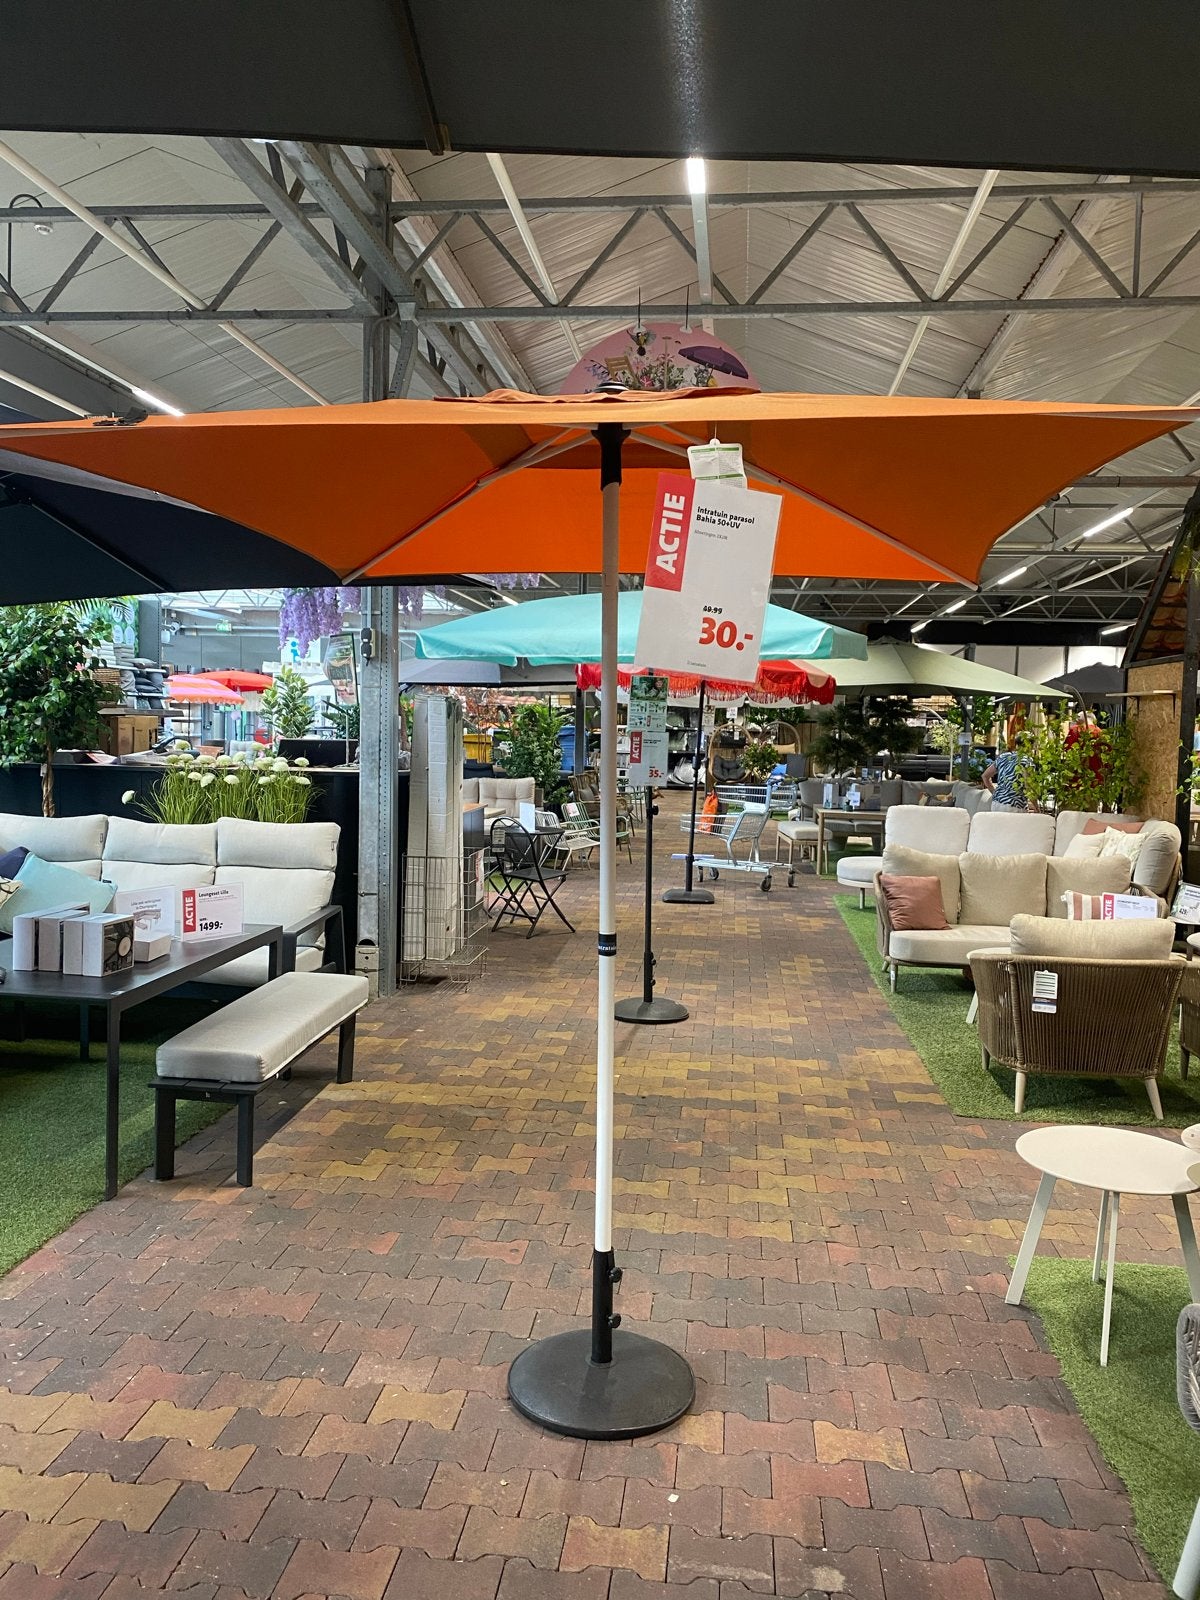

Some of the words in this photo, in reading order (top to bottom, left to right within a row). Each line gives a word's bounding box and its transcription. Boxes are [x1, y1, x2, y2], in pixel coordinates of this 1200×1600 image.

[696, 514, 716, 524] Bahia
[717, 518, 741, 529] 50+UV
[729, 514, 755, 524] parasol
[656, 492, 686, 574] ACTIE
[698, 616, 754, 650] 30.-
[632, 736, 640, 759] ACTIE
[186, 896, 194, 926] ACTIE
